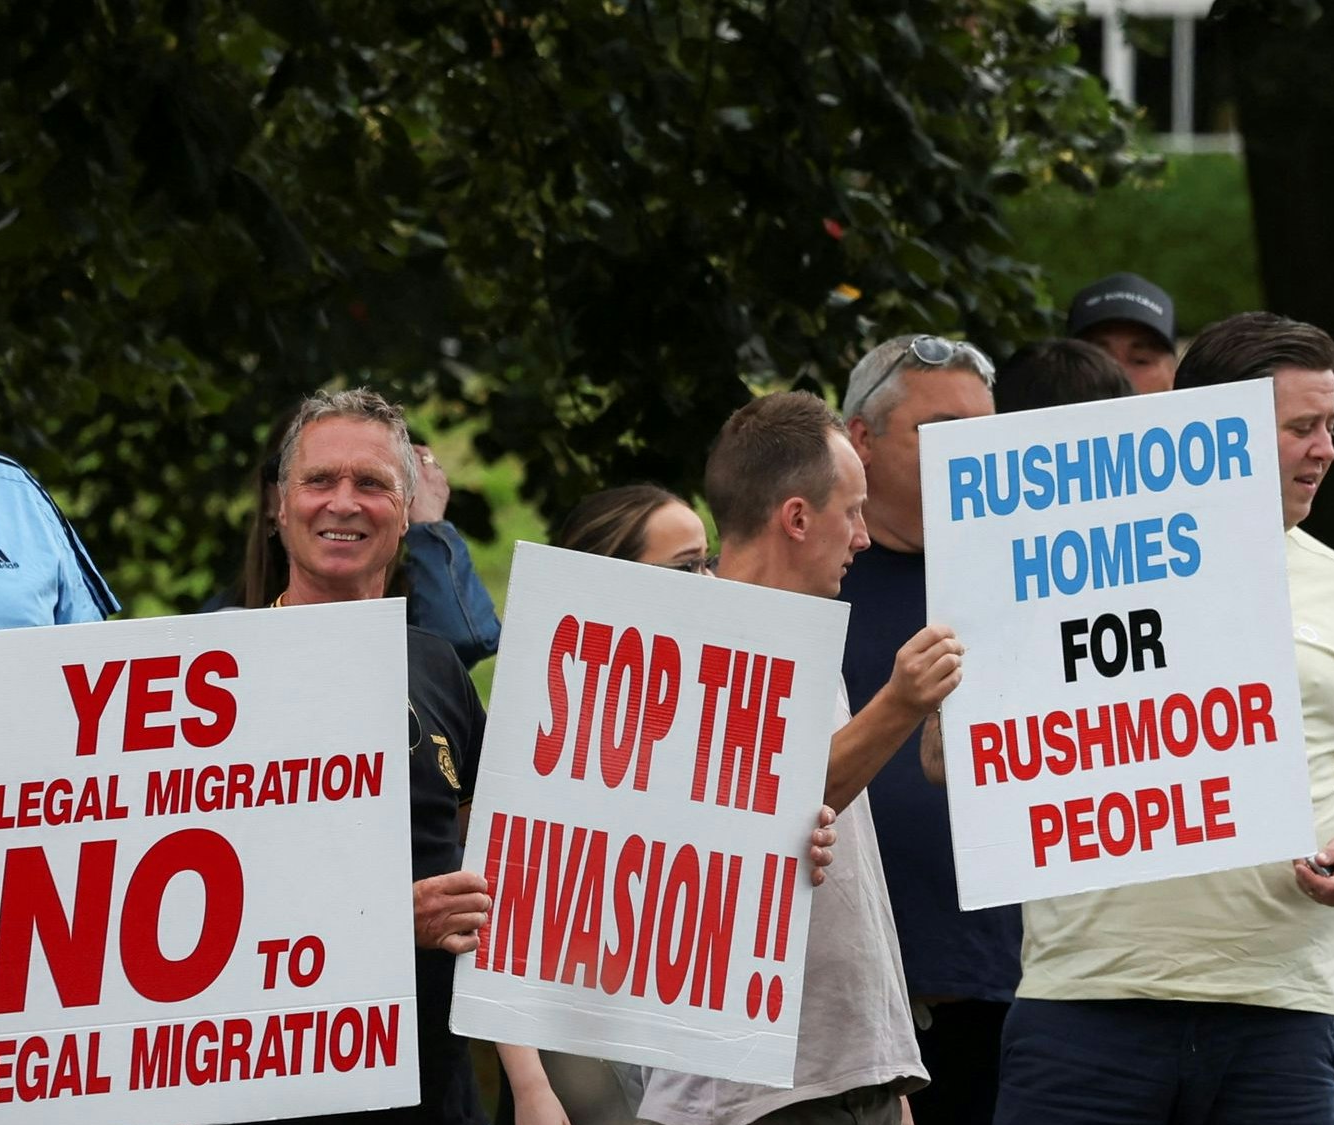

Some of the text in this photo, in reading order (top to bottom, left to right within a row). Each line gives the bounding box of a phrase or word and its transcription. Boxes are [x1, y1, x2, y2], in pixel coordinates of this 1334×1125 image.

[948, 417, 1253, 521] RUSHMOOR
[1012, 512, 1201, 602] HOMES
[1060, 608, 1167, 683] FOR
[62, 650, 239, 756] YES
[533, 614, 795, 815] STOP THE
[970, 683, 1277, 786] RUSHMOOR
[145, 752, 384, 817] MIGRATION
[1029, 776, 1236, 867] PEOPLE
[475, 812, 742, 1011] INVASION
[257, 935, 326, 990] TO
[129, 1004, 400, 1091] MIGRATION
